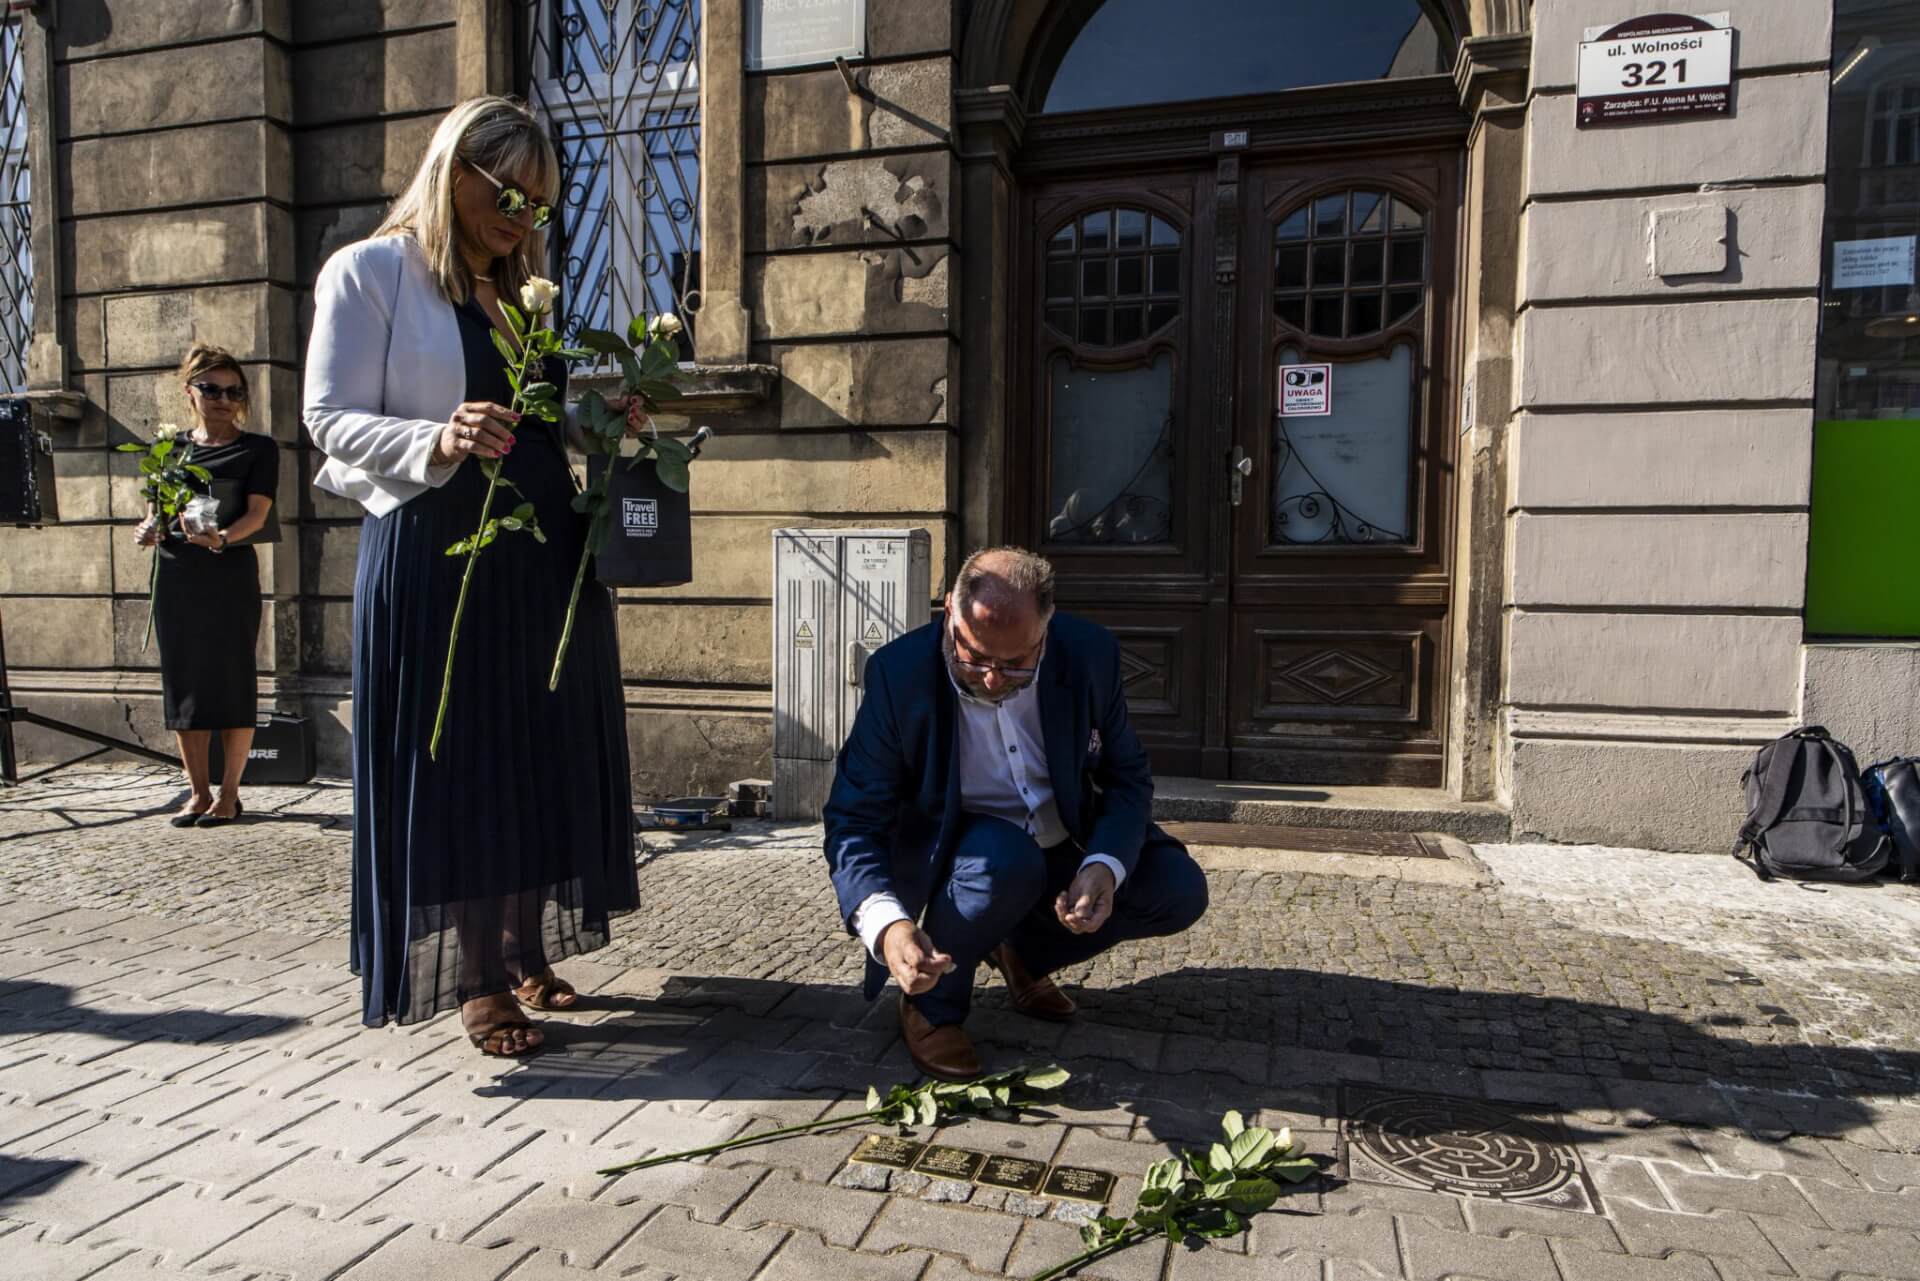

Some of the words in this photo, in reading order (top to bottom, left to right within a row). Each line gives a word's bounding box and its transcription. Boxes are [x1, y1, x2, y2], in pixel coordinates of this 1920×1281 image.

[1607, 44, 1626, 57] ul.
[1632, 37, 1703, 55] Wolności
[1621, 58, 1688, 88] 321
[1603, 99, 1643, 111] Zarządca:
[1687, 94, 1698, 103] M.
[1287, 389, 1323, 397] UWAGA
[624, 501, 655, 512] Travel
[625, 512, 656, 525] FREE
[248, 749, 280, 759] URE
